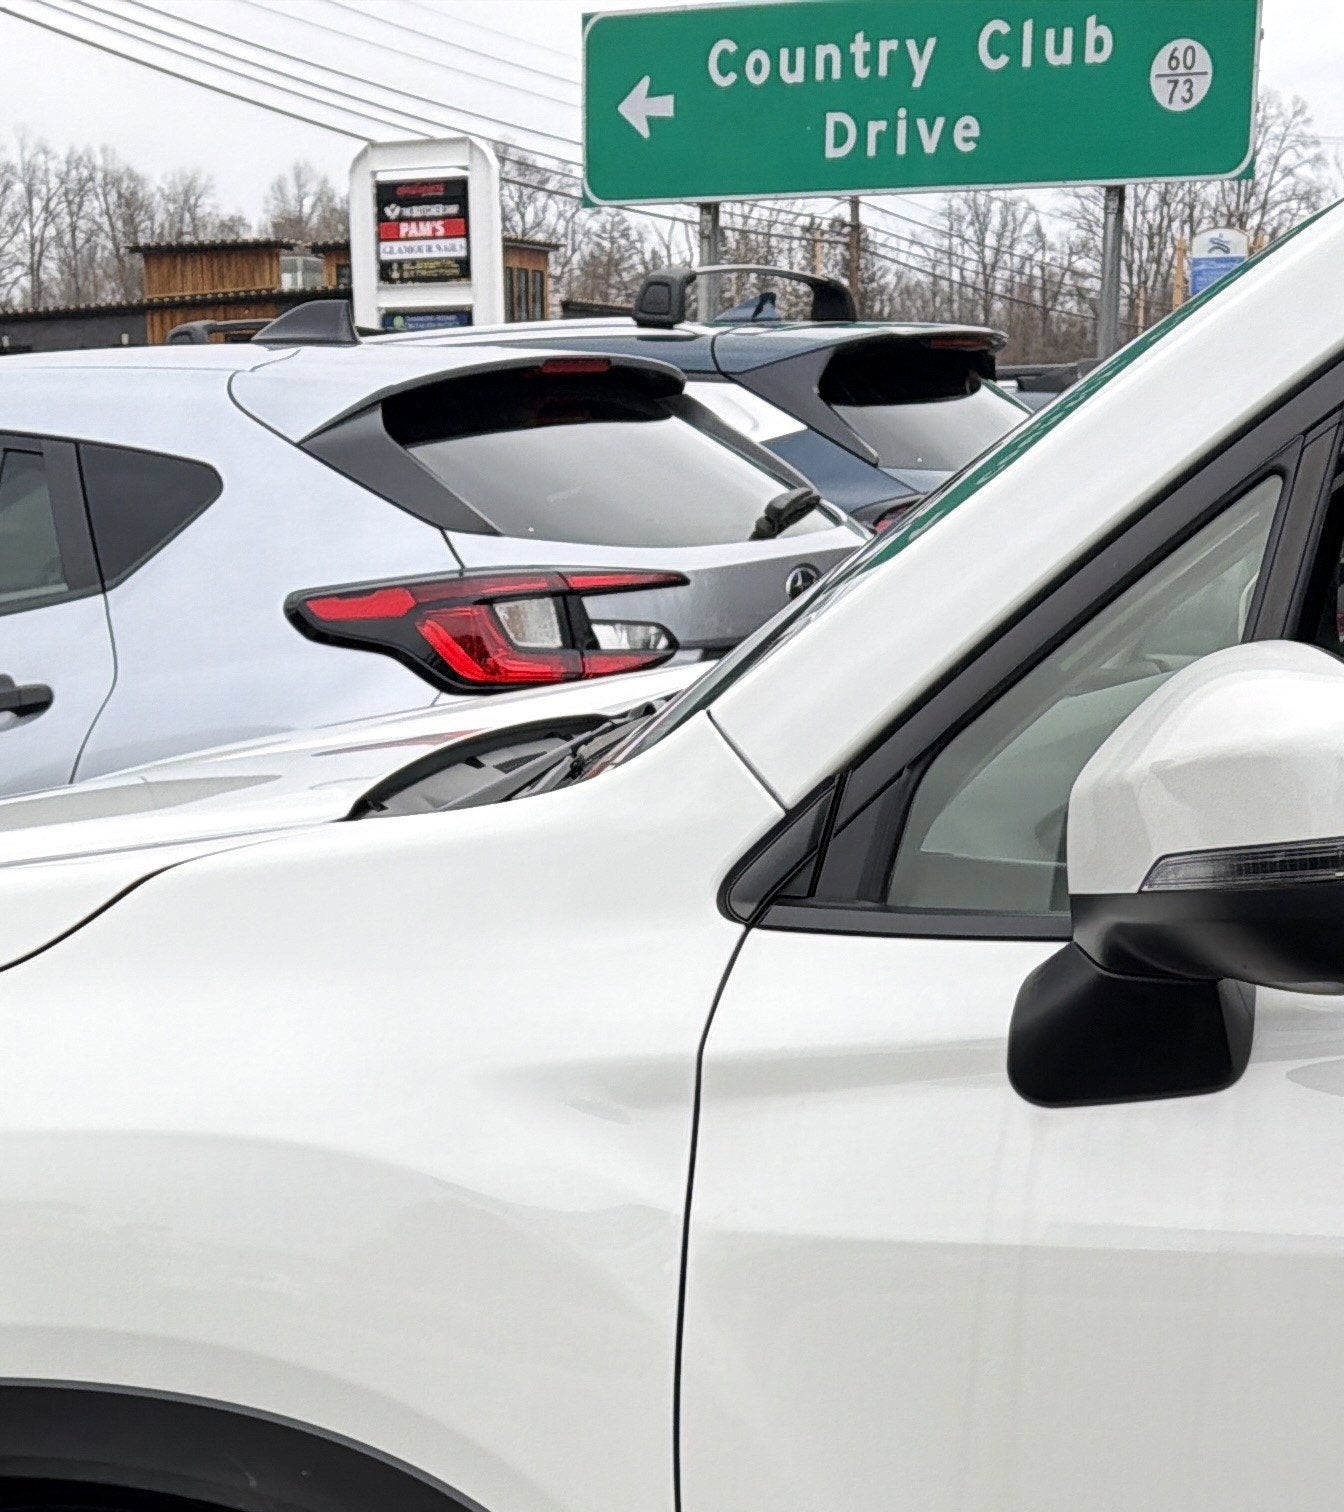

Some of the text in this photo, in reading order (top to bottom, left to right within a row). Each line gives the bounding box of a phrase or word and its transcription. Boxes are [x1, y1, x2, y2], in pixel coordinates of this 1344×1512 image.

[708, 15, 1114, 88] Country Club
[1167, 44, 1197, 72] 60
[1166, 77, 1194, 105] 73
[824, 107, 981, 159] Drive
[398, 219, 445, 239] PAM'S
